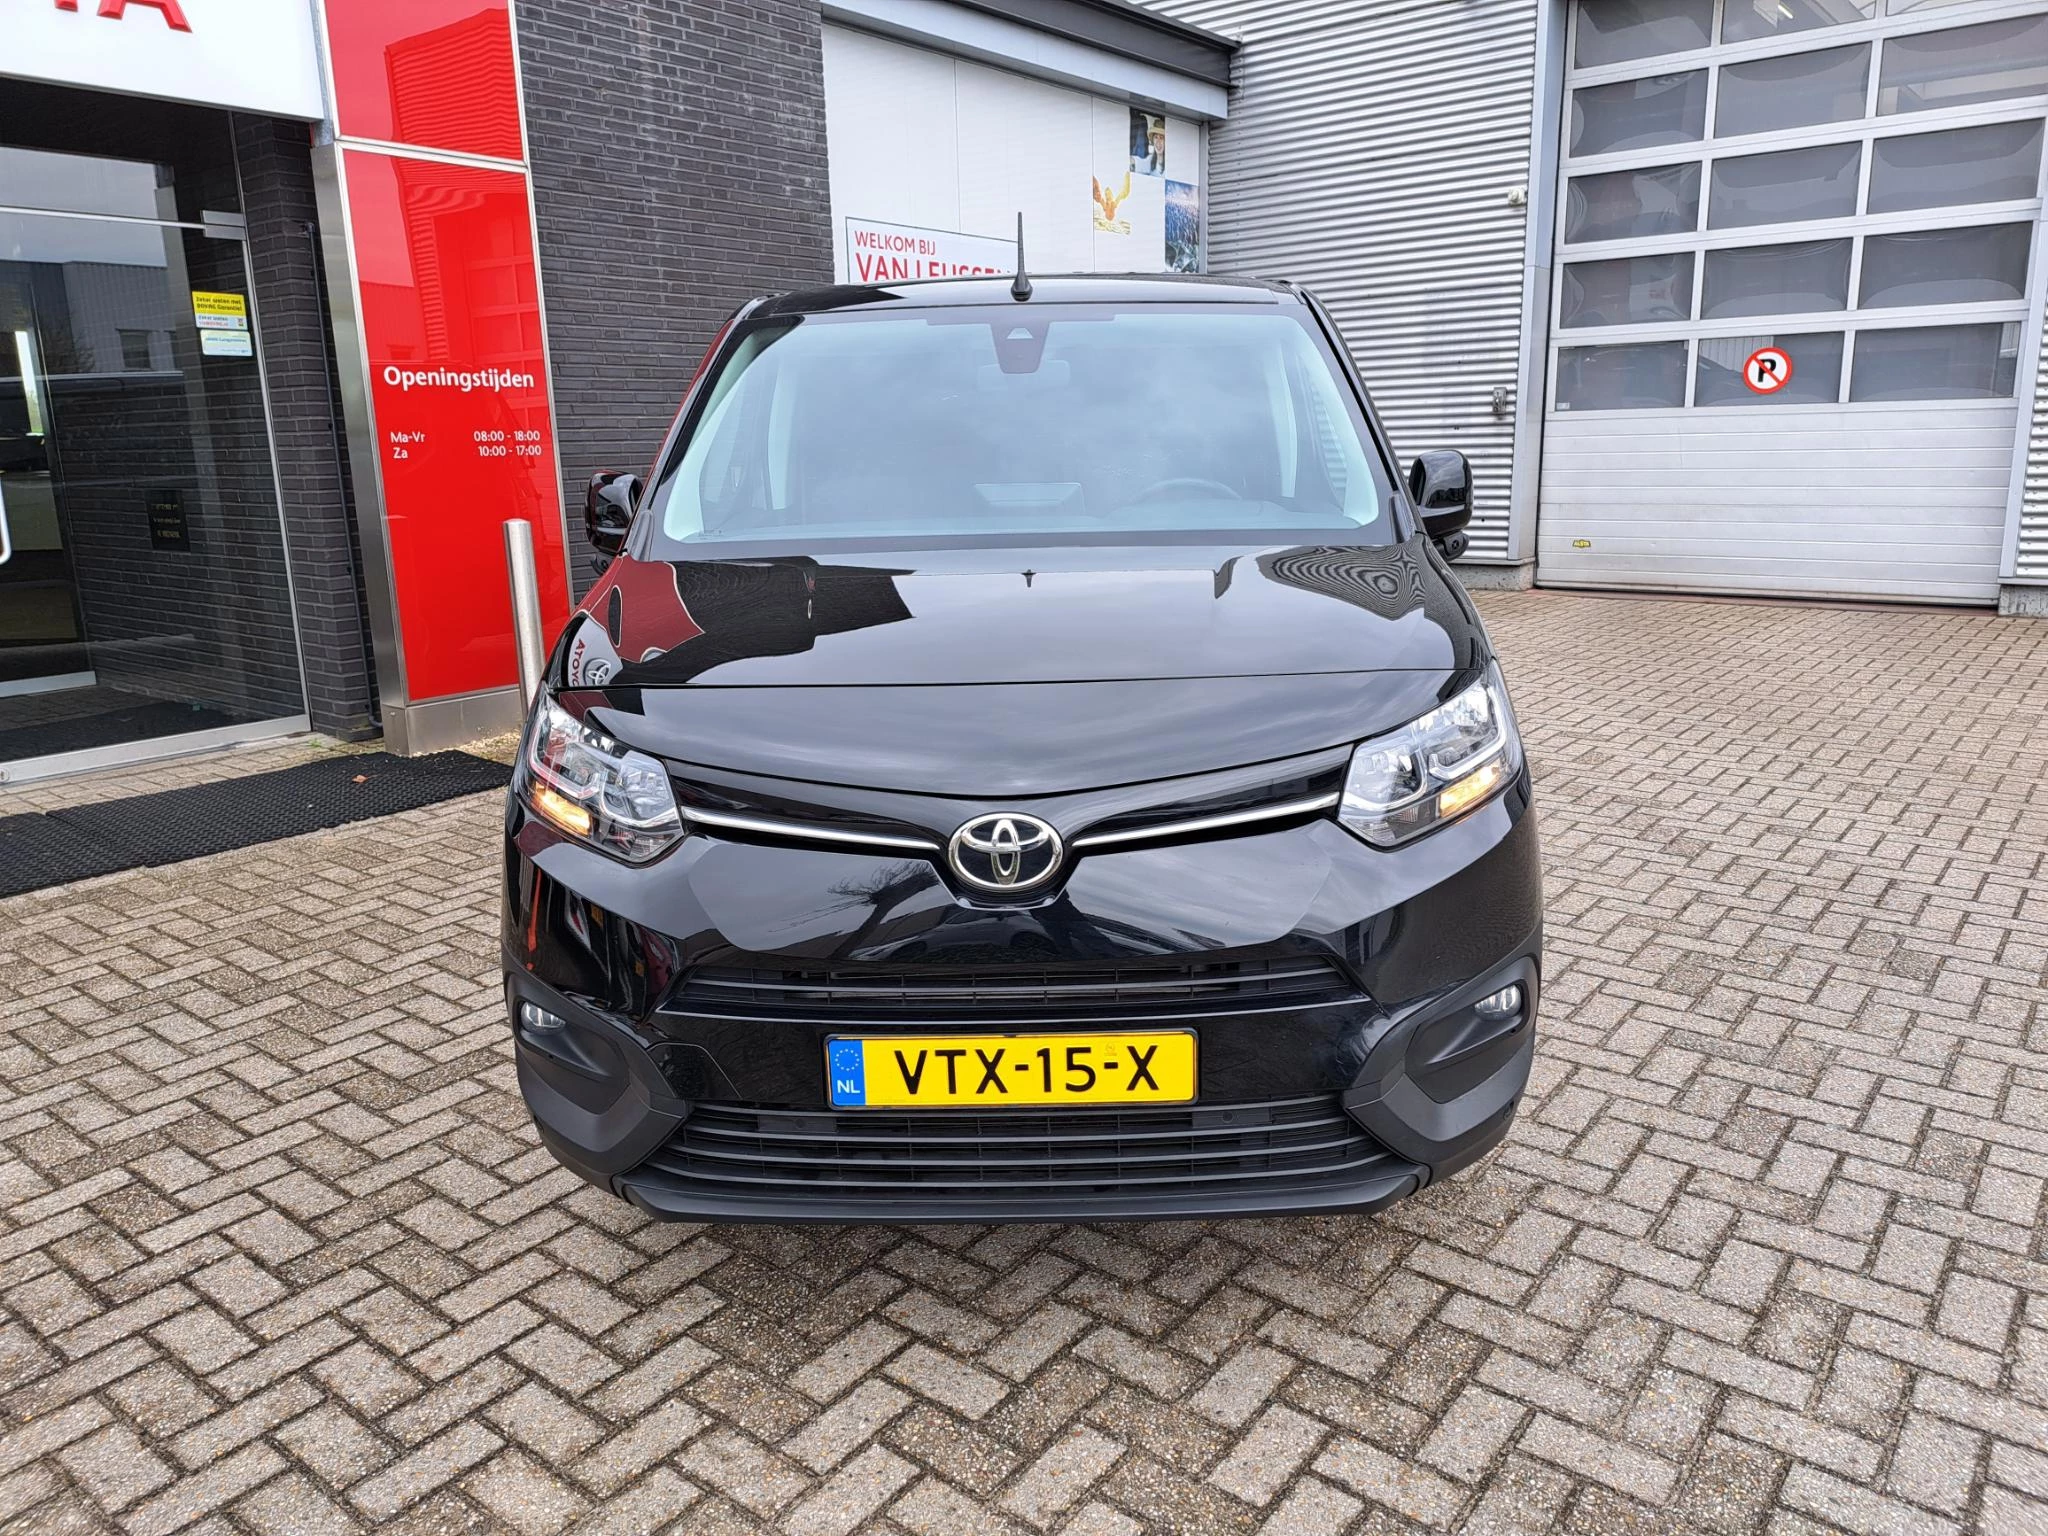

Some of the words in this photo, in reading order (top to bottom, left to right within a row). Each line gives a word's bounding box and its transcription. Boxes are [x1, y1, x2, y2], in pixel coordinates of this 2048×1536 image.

[854, 230, 915, 253] WELKOM
[919, 239, 936, 256] BIJ
[855, 252, 908, 282] VAN
[383, 366, 535, 392] Openingstijden
[1757, 358, 1777, 383] P
[390, 431, 426, 444] Ma-Vr
[473, 430, 504, 442] 08:00
[514, 430, 541, 442] 18:00
[393, 447, 408, 459] Za
[478, 445, 507, 457] 10:00
[516, 445, 542, 457] 17:00
[894, 1045, 1160, 1095] VTX-15-X
[837, 1080, 860, 1094] NL
